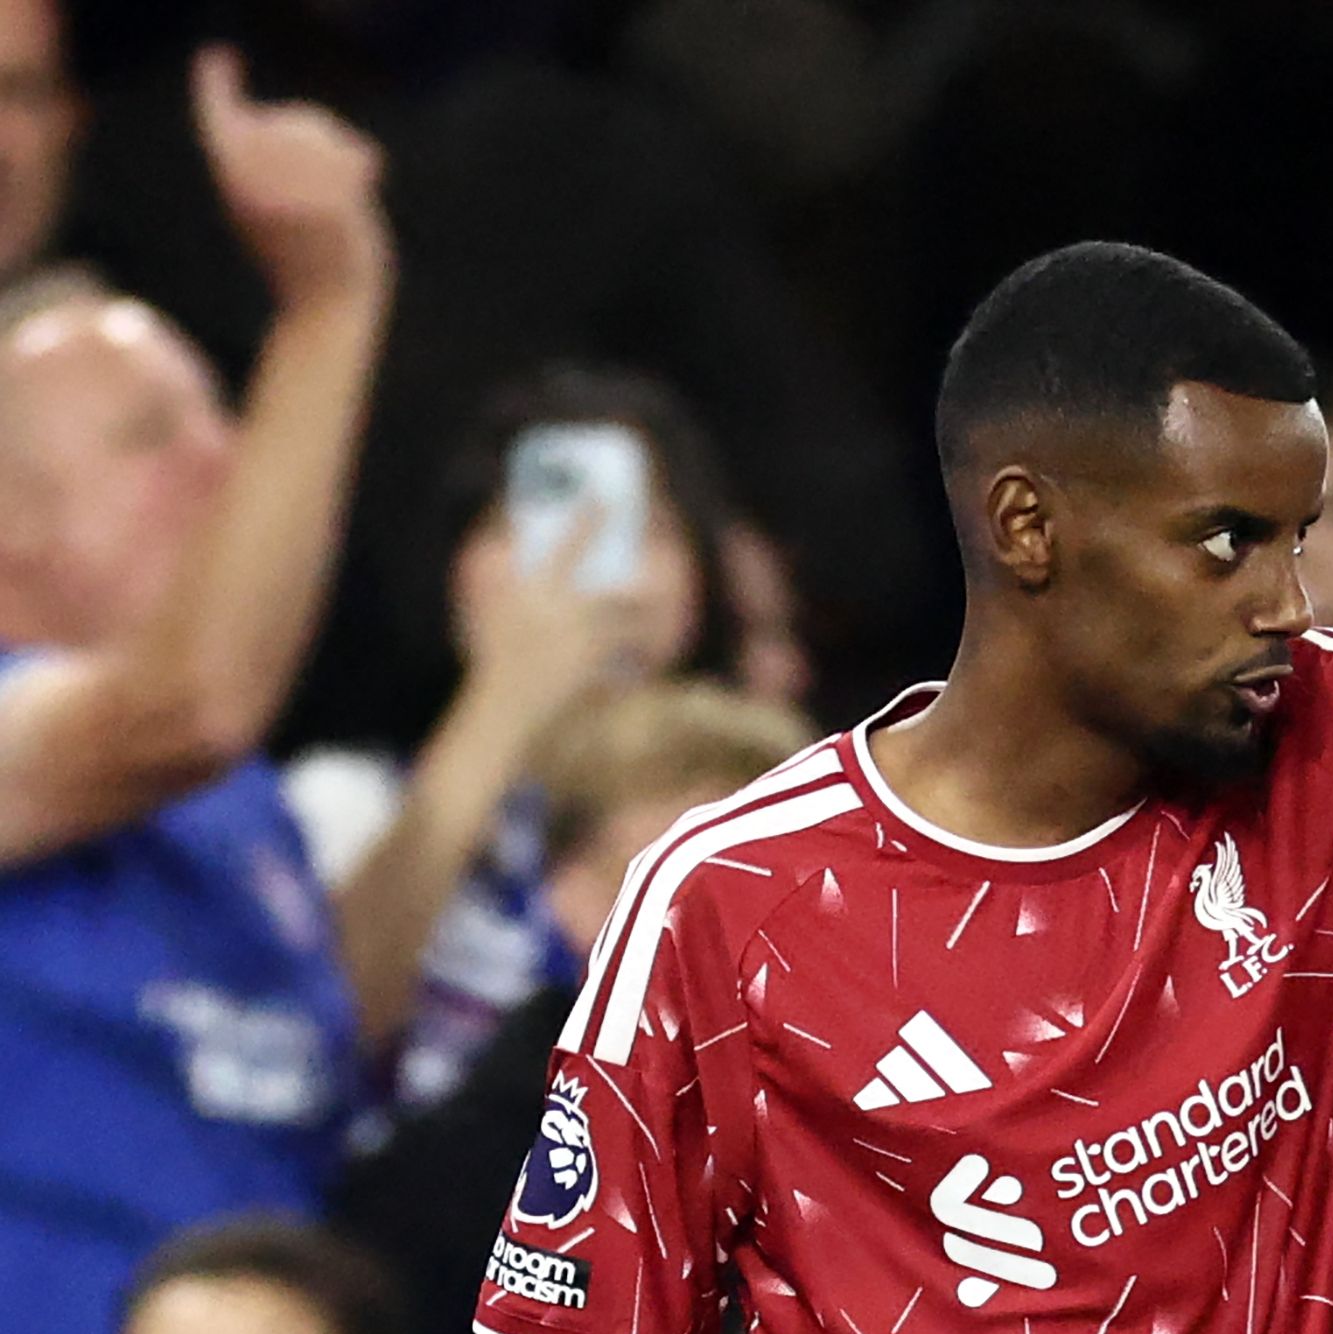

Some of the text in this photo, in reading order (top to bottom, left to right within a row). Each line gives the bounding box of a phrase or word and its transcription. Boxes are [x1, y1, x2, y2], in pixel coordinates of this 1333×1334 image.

[1219, 933, 1295, 999] L.F.C.
[1051, 1026, 1285, 1199] standard
[1070, 1065, 1313, 1247] chartered
[496, 1264, 586, 1309] racism
[502, 1242, 576, 1285] room
